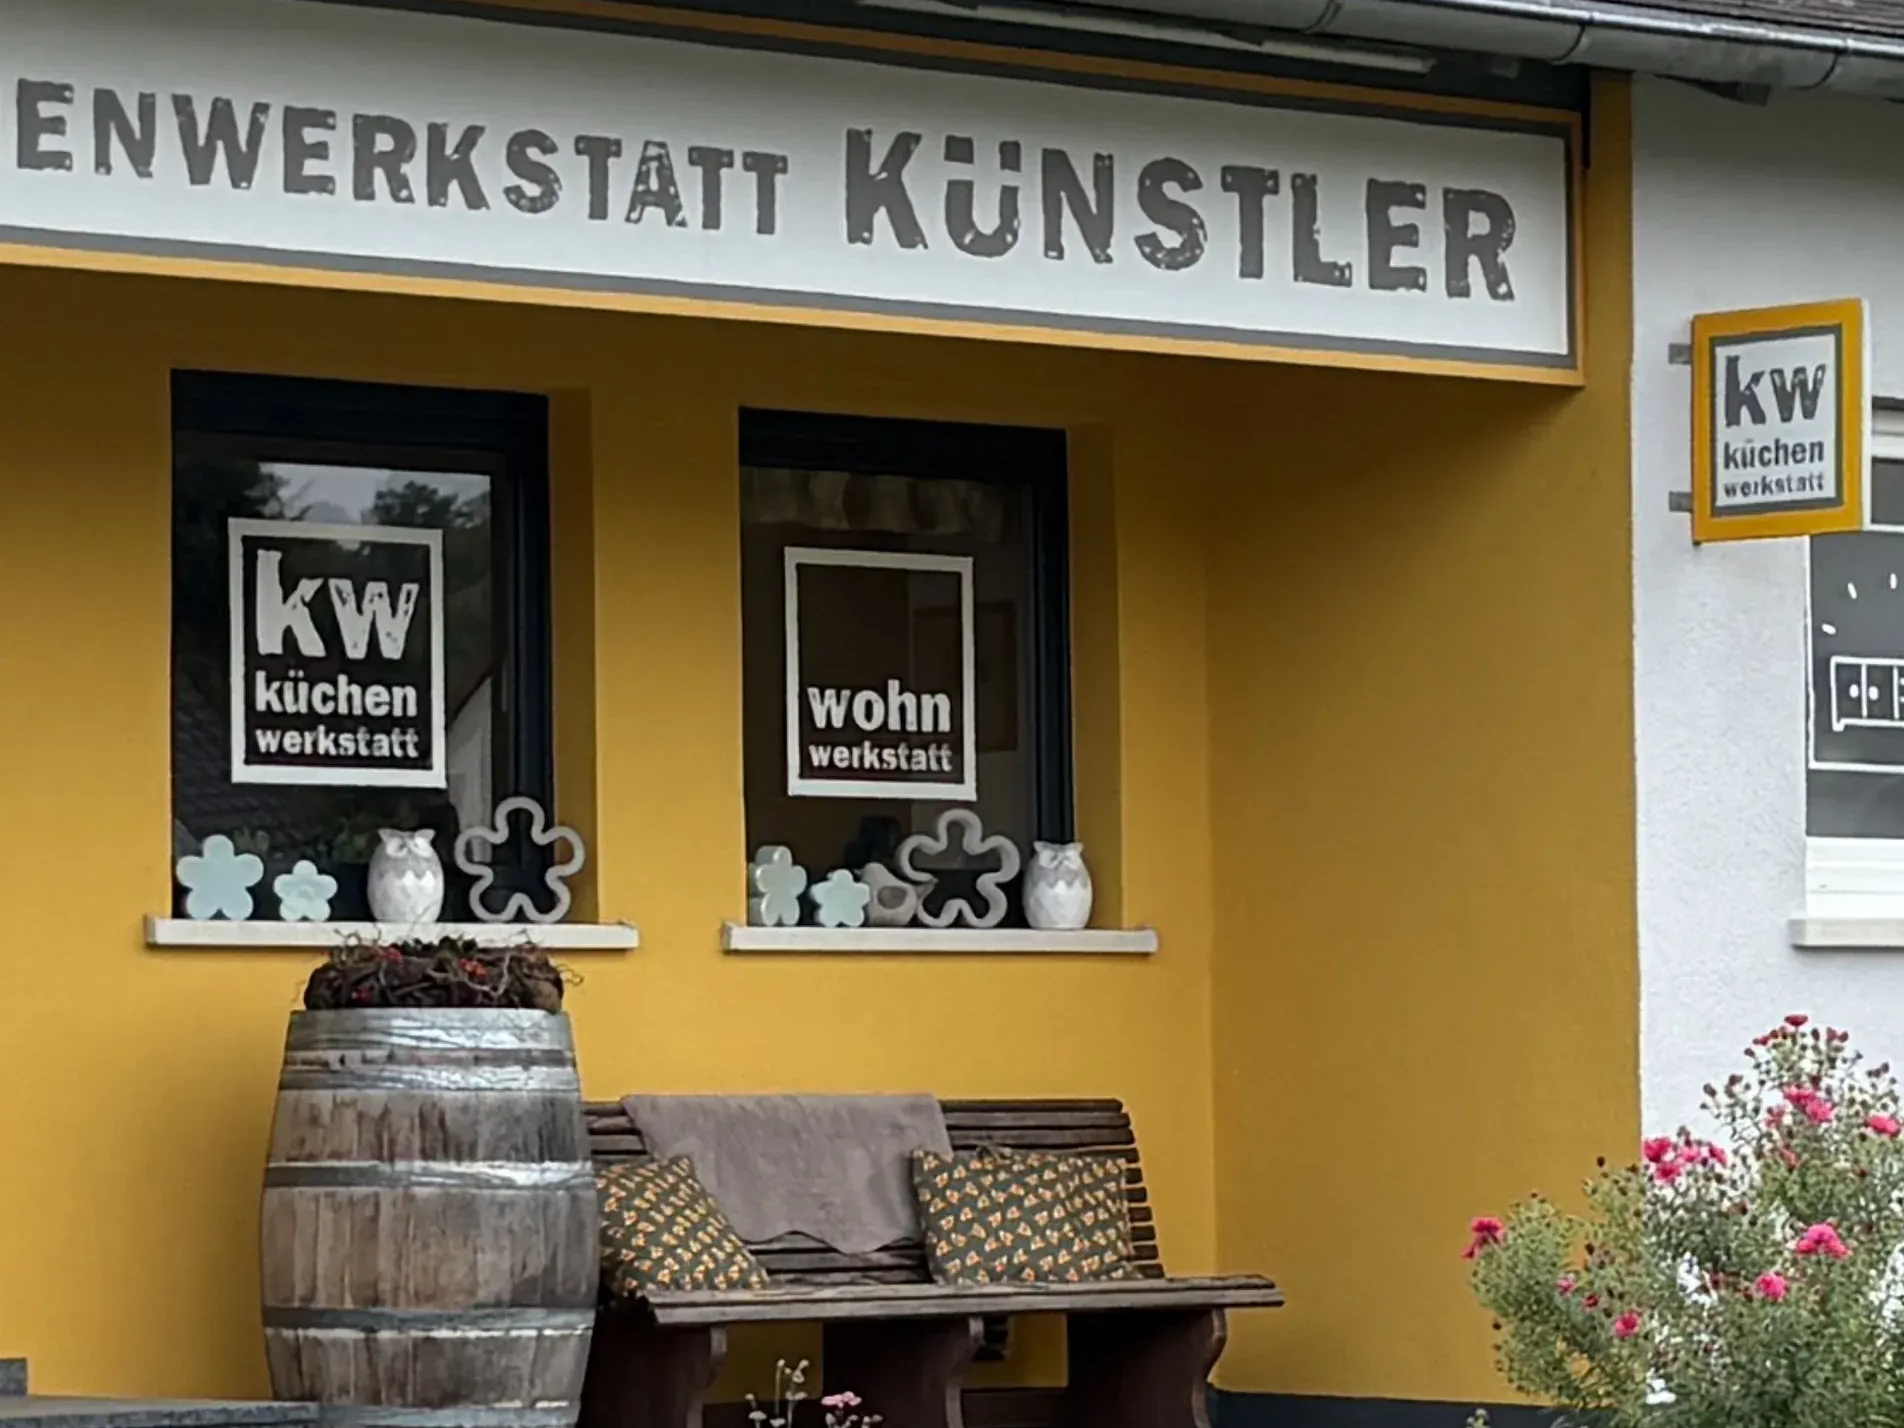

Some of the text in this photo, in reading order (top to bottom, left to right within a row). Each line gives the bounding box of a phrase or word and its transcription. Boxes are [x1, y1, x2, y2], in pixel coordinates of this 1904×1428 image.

[844, 127, 1516, 302] KÜNSTLER
[1724, 354, 1827, 428] kw
[1723, 437, 1825, 471] küchen
[1723, 473, 1825, 499] werkstatt
[255, 548, 421, 660] kw
[255, 669, 418, 717] küchen
[806, 678, 952, 733] wohn
[254, 724, 419, 758] werkstatt
[807, 739, 954, 772] werkstatt
